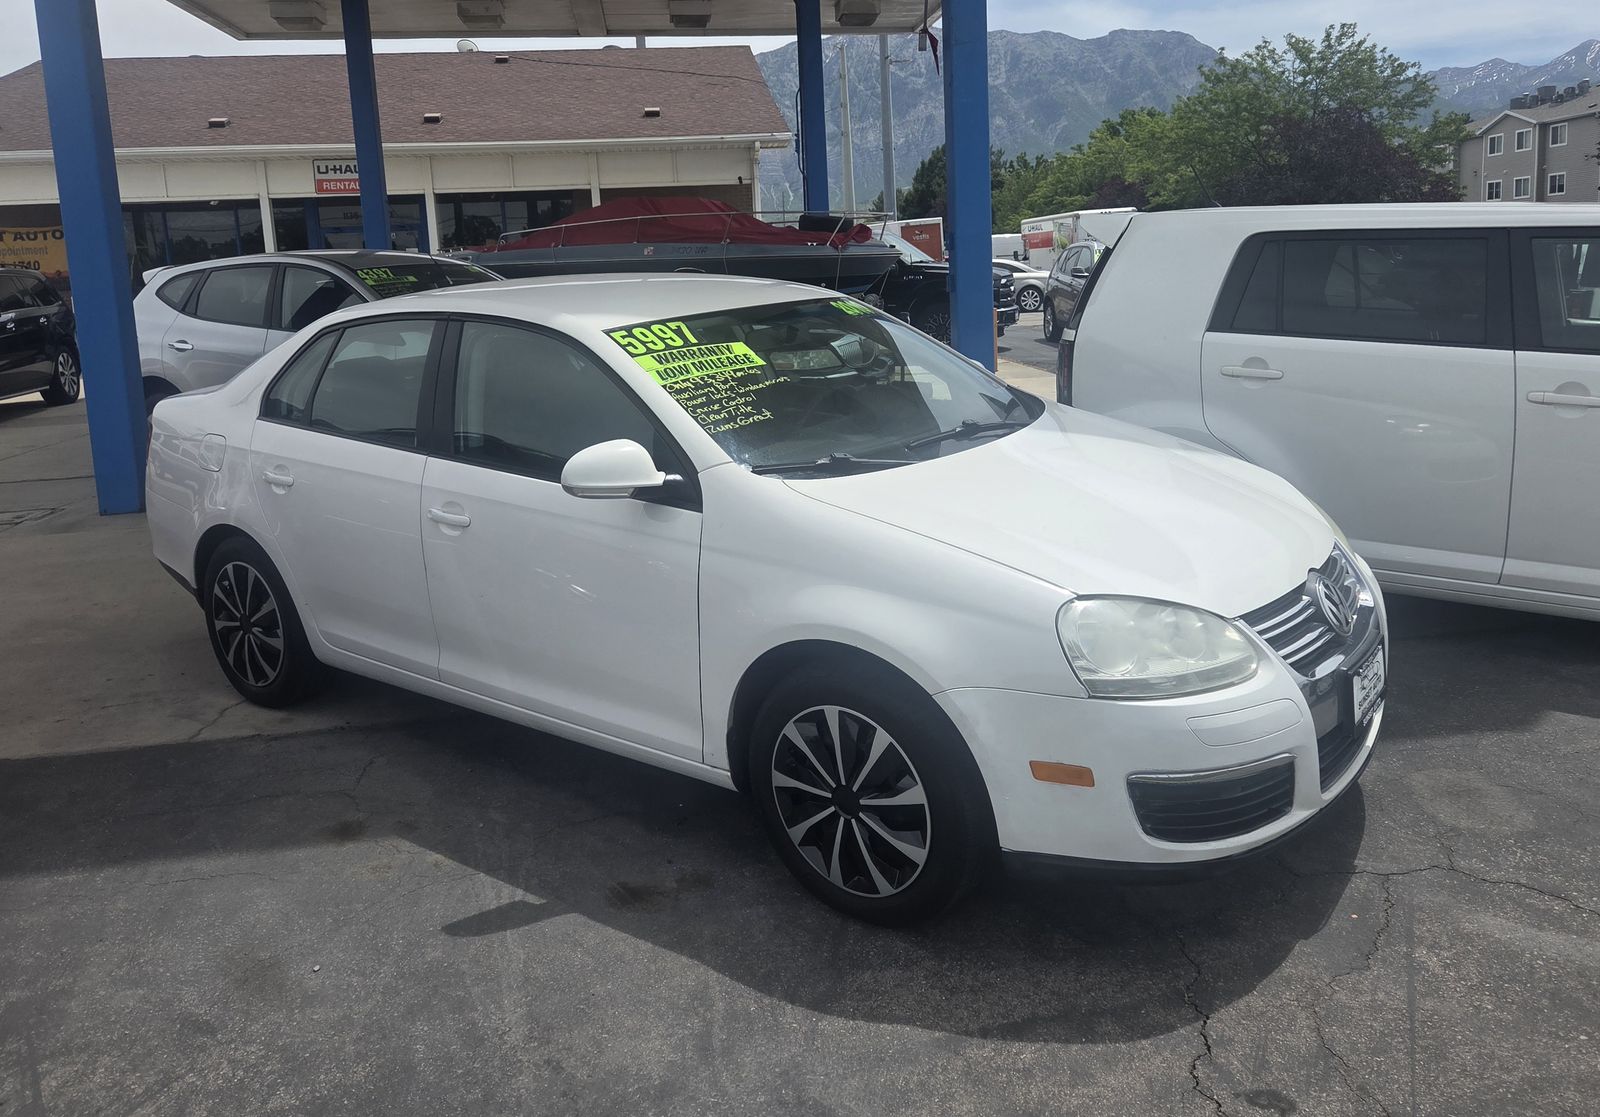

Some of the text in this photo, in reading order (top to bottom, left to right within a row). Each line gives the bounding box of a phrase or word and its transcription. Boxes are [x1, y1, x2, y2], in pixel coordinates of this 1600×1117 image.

[13, 229, 64, 241] AUTO
[609, 321, 698, 354] 5997
[650, 344, 734, 366] WARRANTY
[655, 353, 755, 381] LOW MILEAGE
[667, 380, 695, 391] Only
[672, 378, 738, 400] Auxiliary Port
[679, 396, 707, 408] Power
[722, 392, 756, 407] Control
[698, 404, 756, 424] Clean Title
[704, 408, 774, 434] Runs Great
